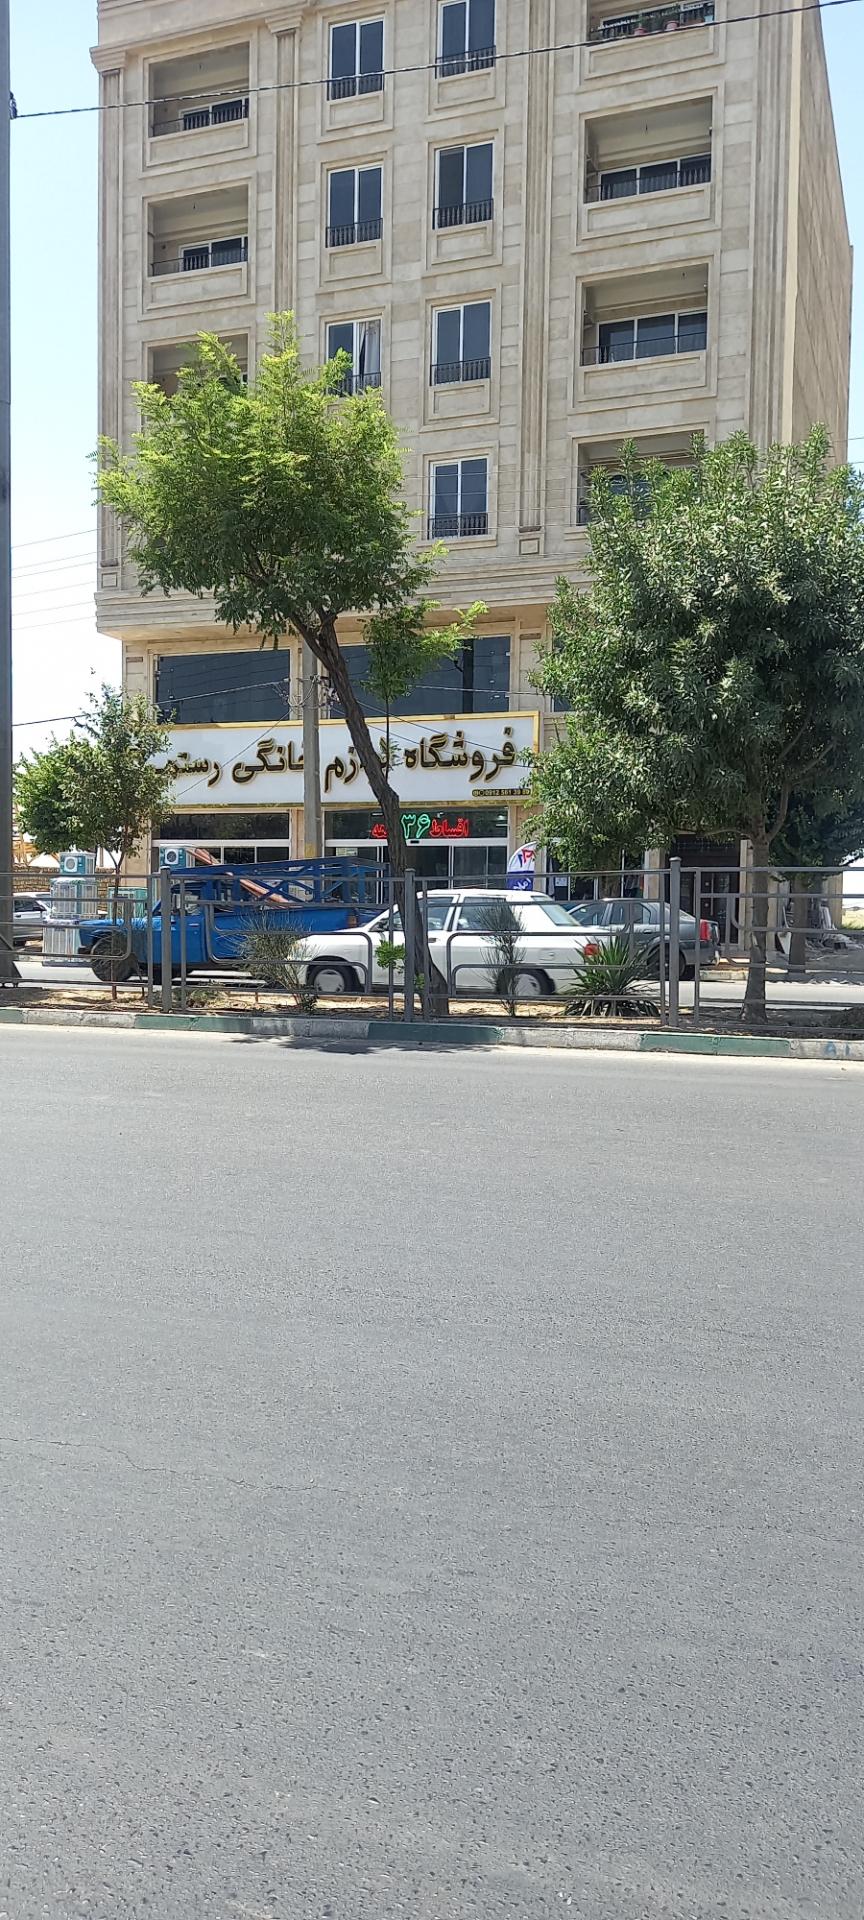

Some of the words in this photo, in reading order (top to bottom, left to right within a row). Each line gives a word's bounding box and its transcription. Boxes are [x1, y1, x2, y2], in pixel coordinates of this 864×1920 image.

[231, 737, 304, 784] انگی
[404, 726, 517, 783] فروشگاه
[400, 813, 431, 840] ۳۶
[429, 817, 469, 838] اقساط
